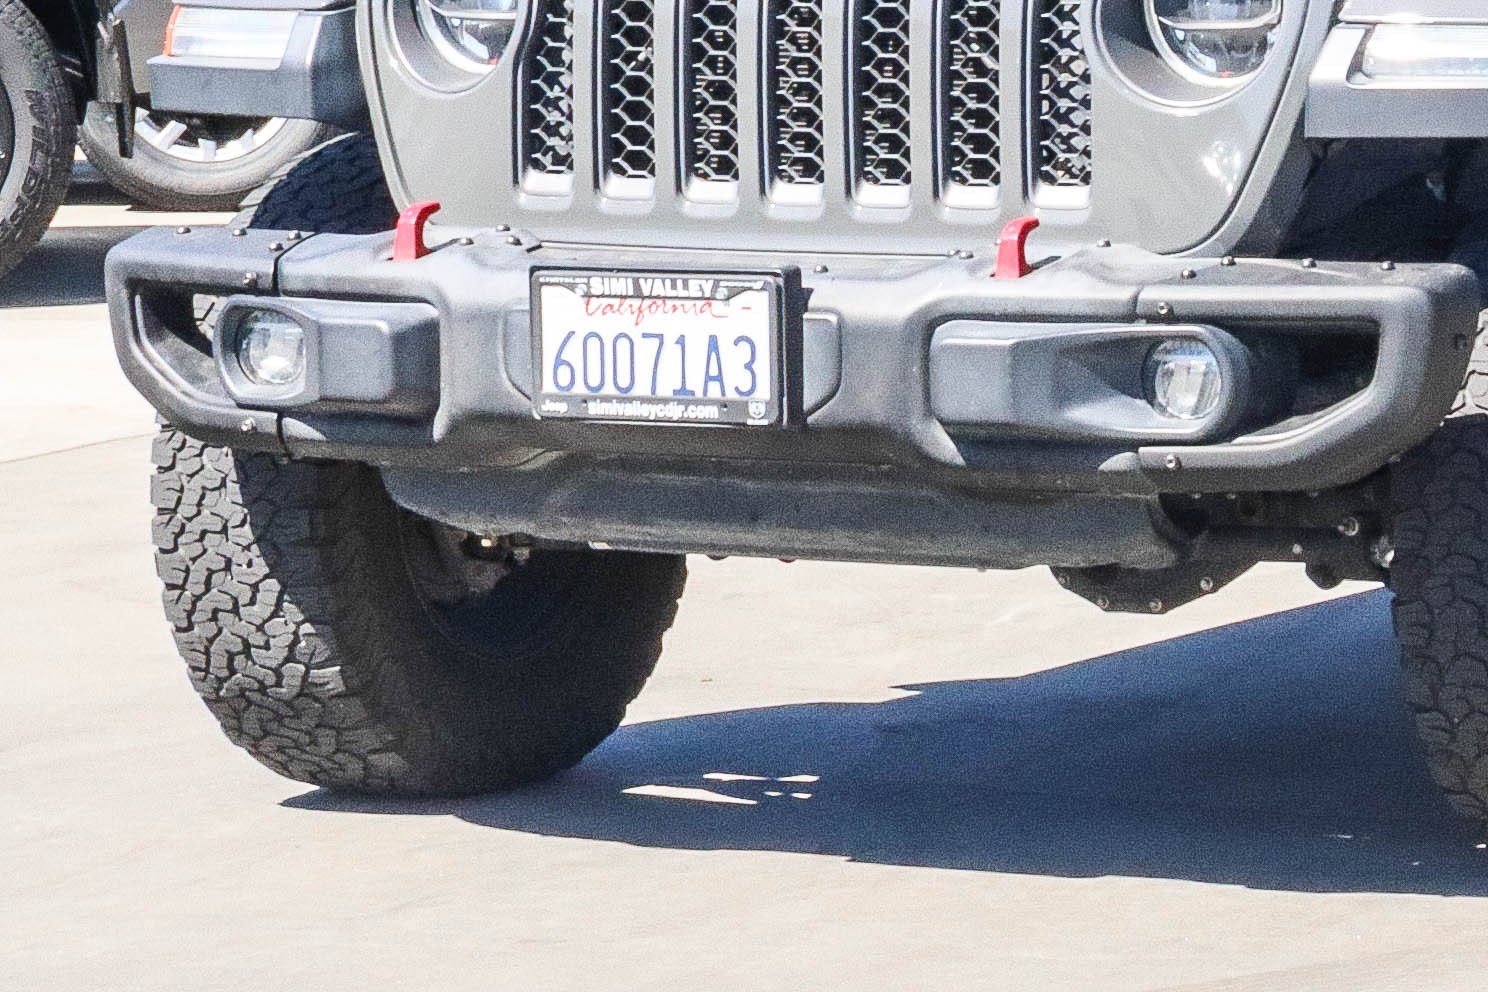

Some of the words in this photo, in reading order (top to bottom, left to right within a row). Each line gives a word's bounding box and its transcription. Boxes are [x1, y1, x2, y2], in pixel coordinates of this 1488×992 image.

[589, 276, 634, 296] SIMI
[638, 278, 714, 298] VALLEY
[584, 295, 728, 326] California
[552, 330, 757, 398] 60071A3
[587, 399, 719, 420] simivalleycdjr.com
